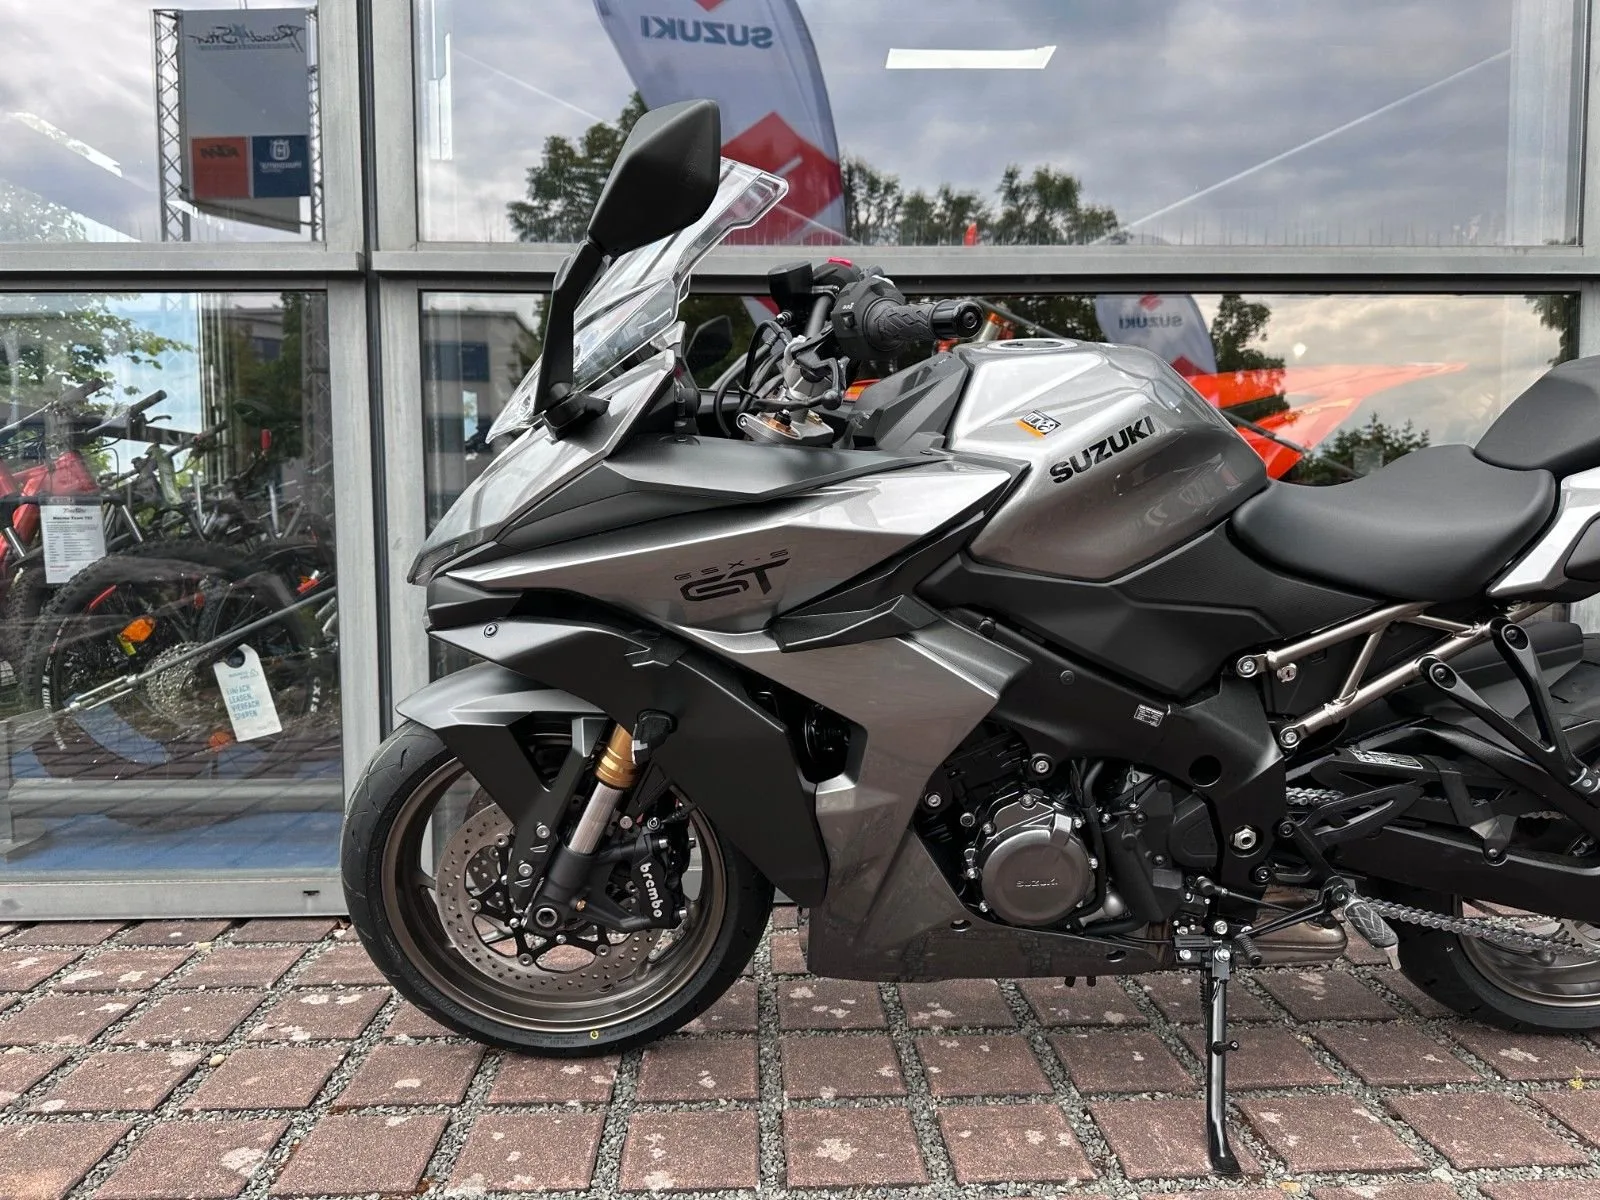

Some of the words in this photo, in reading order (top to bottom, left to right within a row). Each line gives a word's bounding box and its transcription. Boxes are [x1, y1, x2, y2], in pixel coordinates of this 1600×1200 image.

[1050, 415, 1156, 484] SUZUKI
[674, 549, 789, 581] GSX-S
[680, 558, 791, 601] GT
[640, 862, 664, 918] brembo
